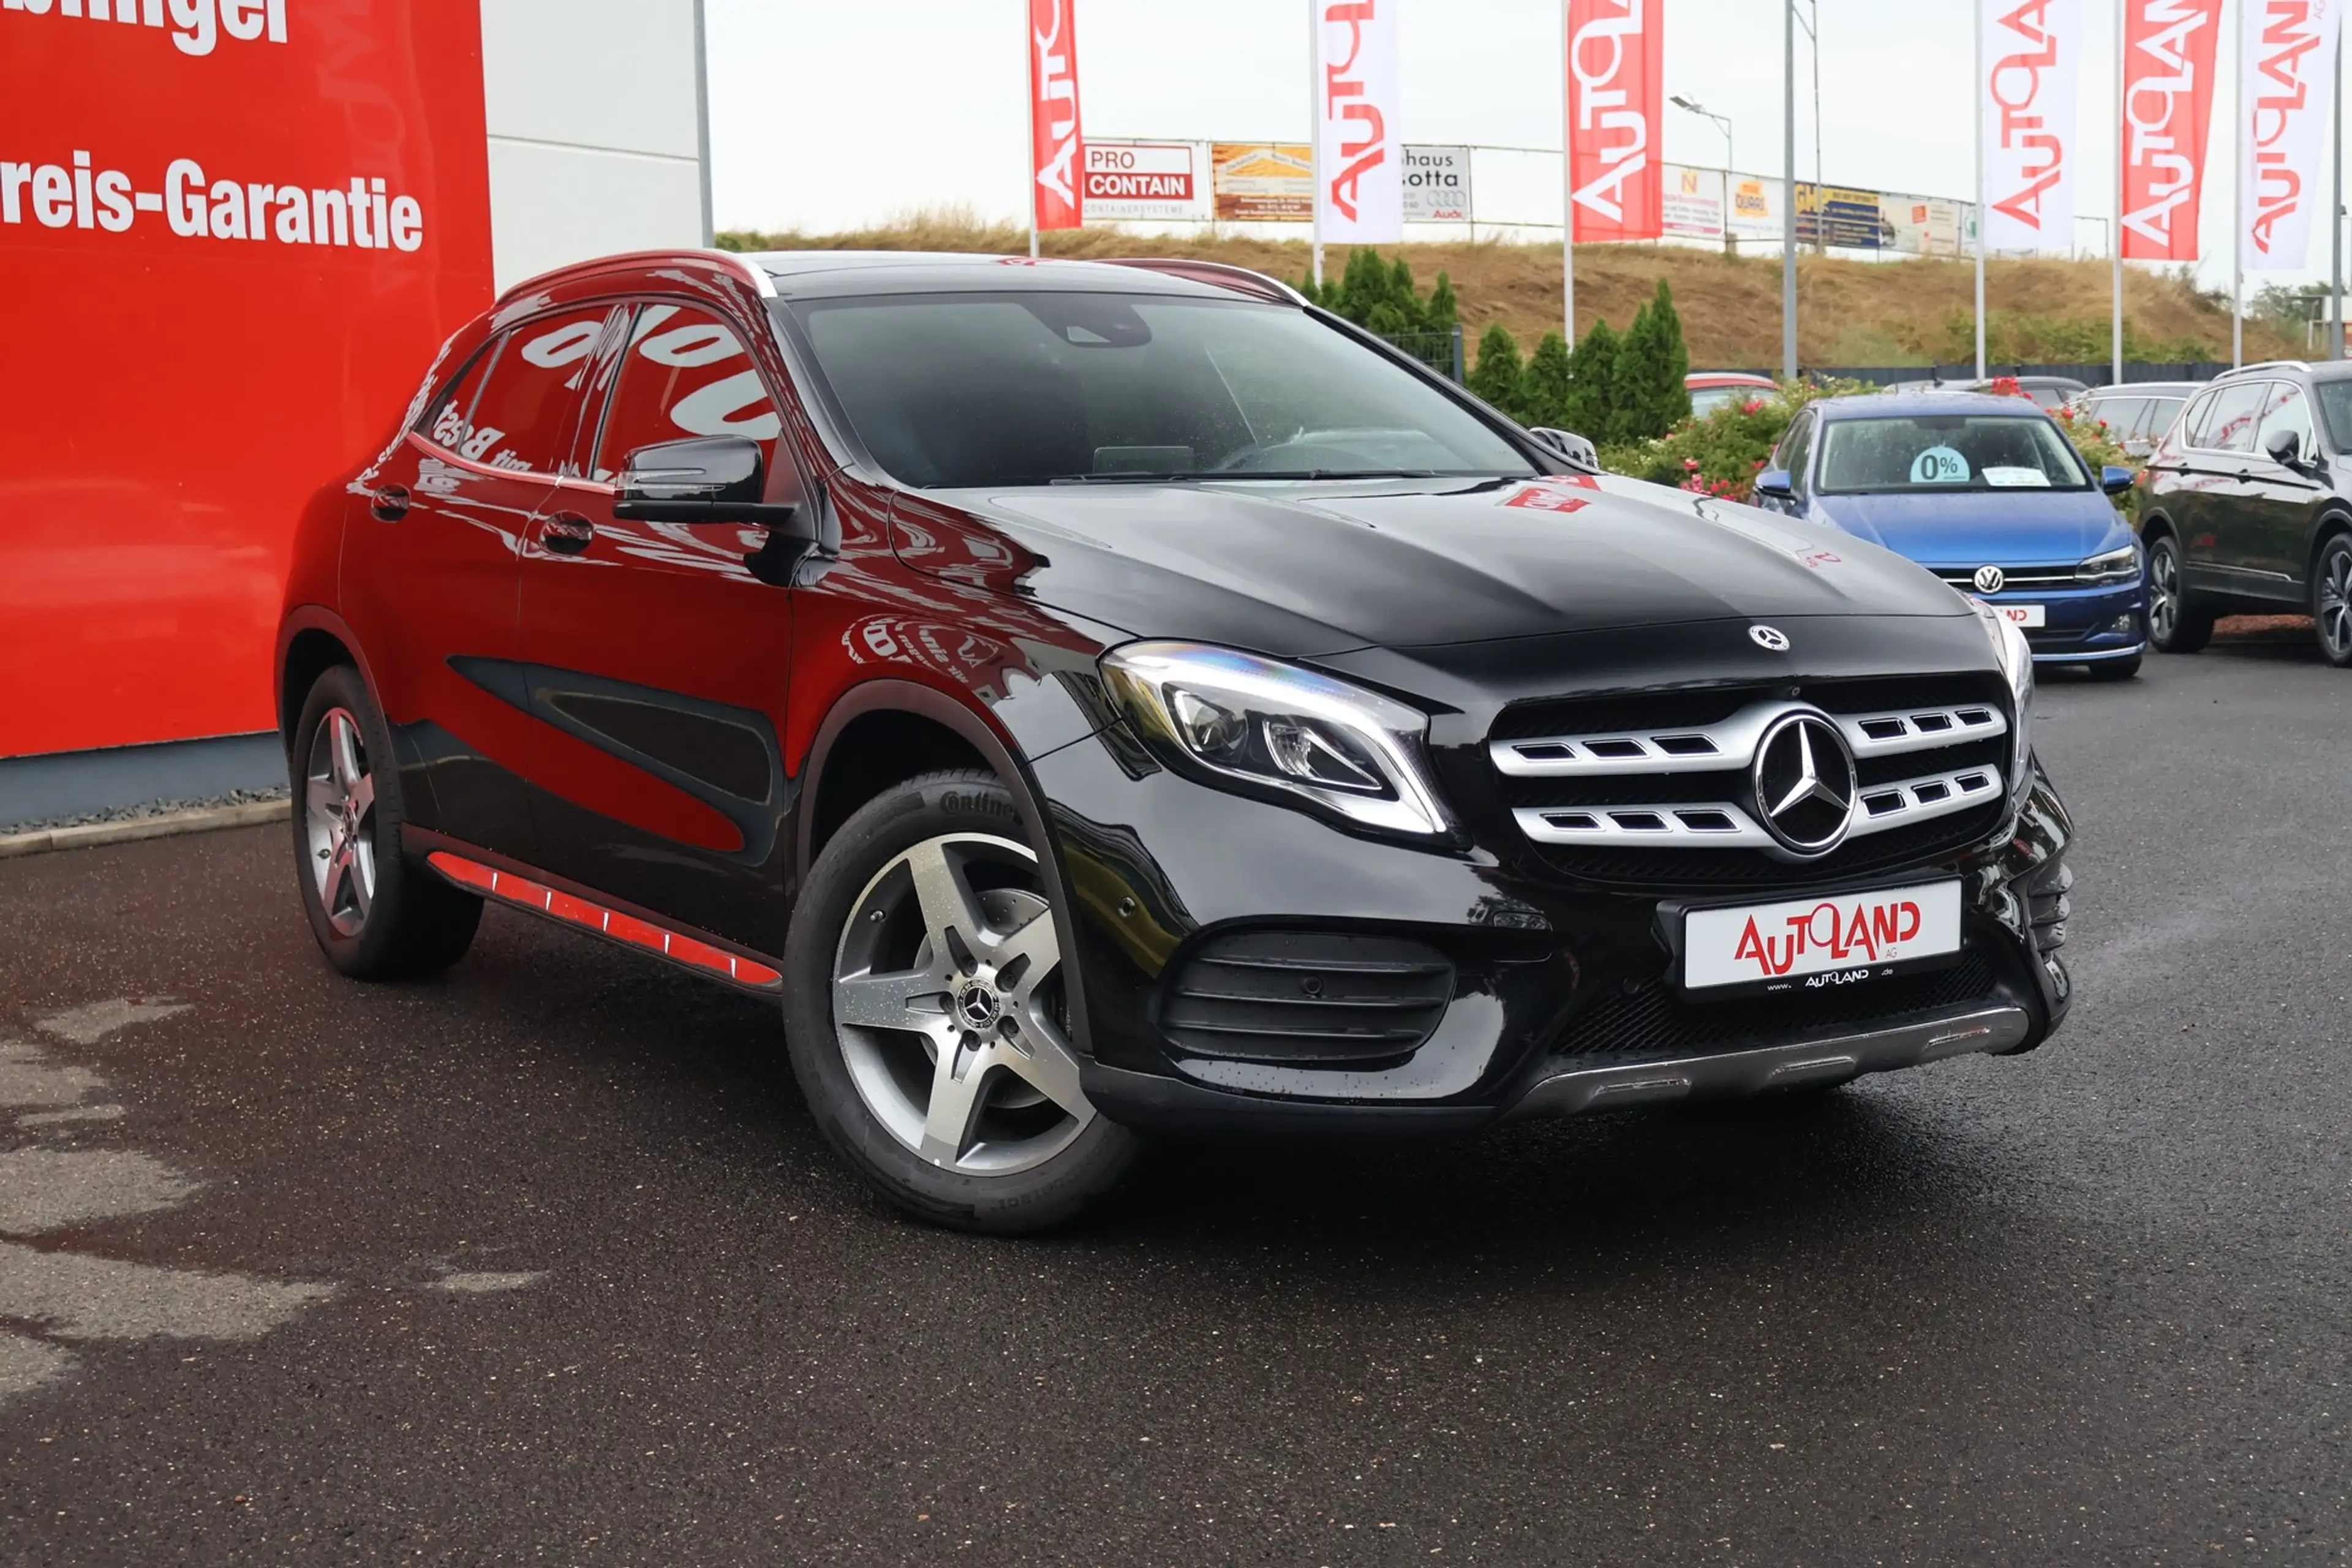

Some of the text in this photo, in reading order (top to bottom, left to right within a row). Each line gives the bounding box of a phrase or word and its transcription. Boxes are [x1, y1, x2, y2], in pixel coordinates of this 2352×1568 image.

[1571, 0, 1646, 223] AUTOL
[1091, 151, 1135, 169] PRO
[1089, 175, 1186, 196] CONTAIN
[0, 149, 423, 252] reis-Garantie
[1433, 209, 1462, 218] Audi
[1920, 454, 1958, 480] 0%
[1734, 902, 1921, 976] AUTOLAND
[1885, 947, 1898, 960] AG
[1804, 970, 1869, 988] AUTOLAND
